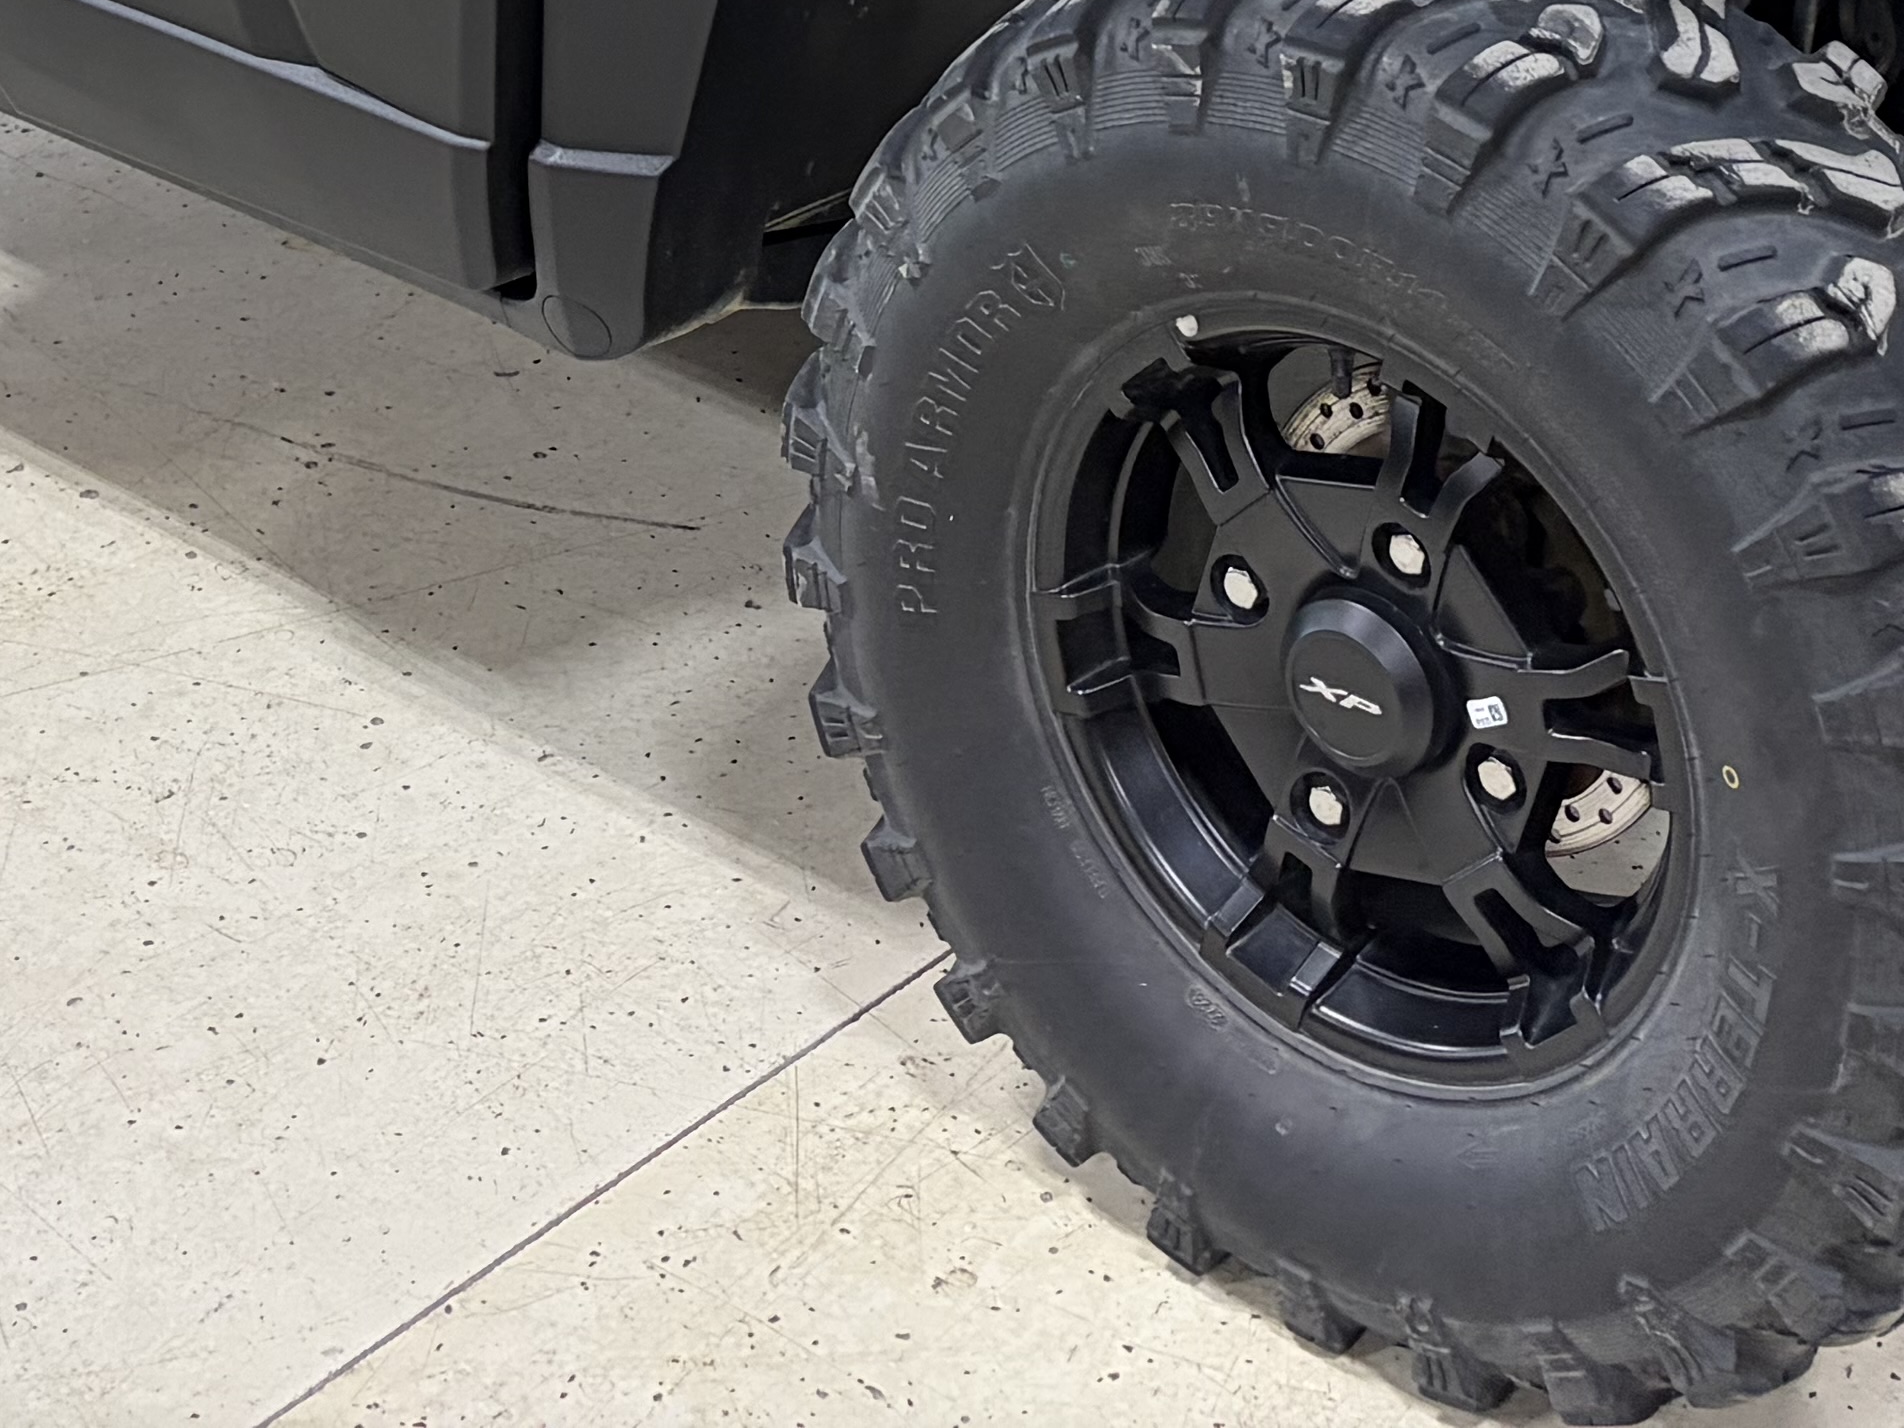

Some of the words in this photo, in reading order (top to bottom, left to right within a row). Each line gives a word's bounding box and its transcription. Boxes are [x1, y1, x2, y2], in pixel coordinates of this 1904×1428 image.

[903, 288, 1023, 482] ARMOR
[896, 493, 938, 615] PRO
[1298, 675, 1383, 716] XP
[1571, 849, 1781, 1232] X-TERRAIN
